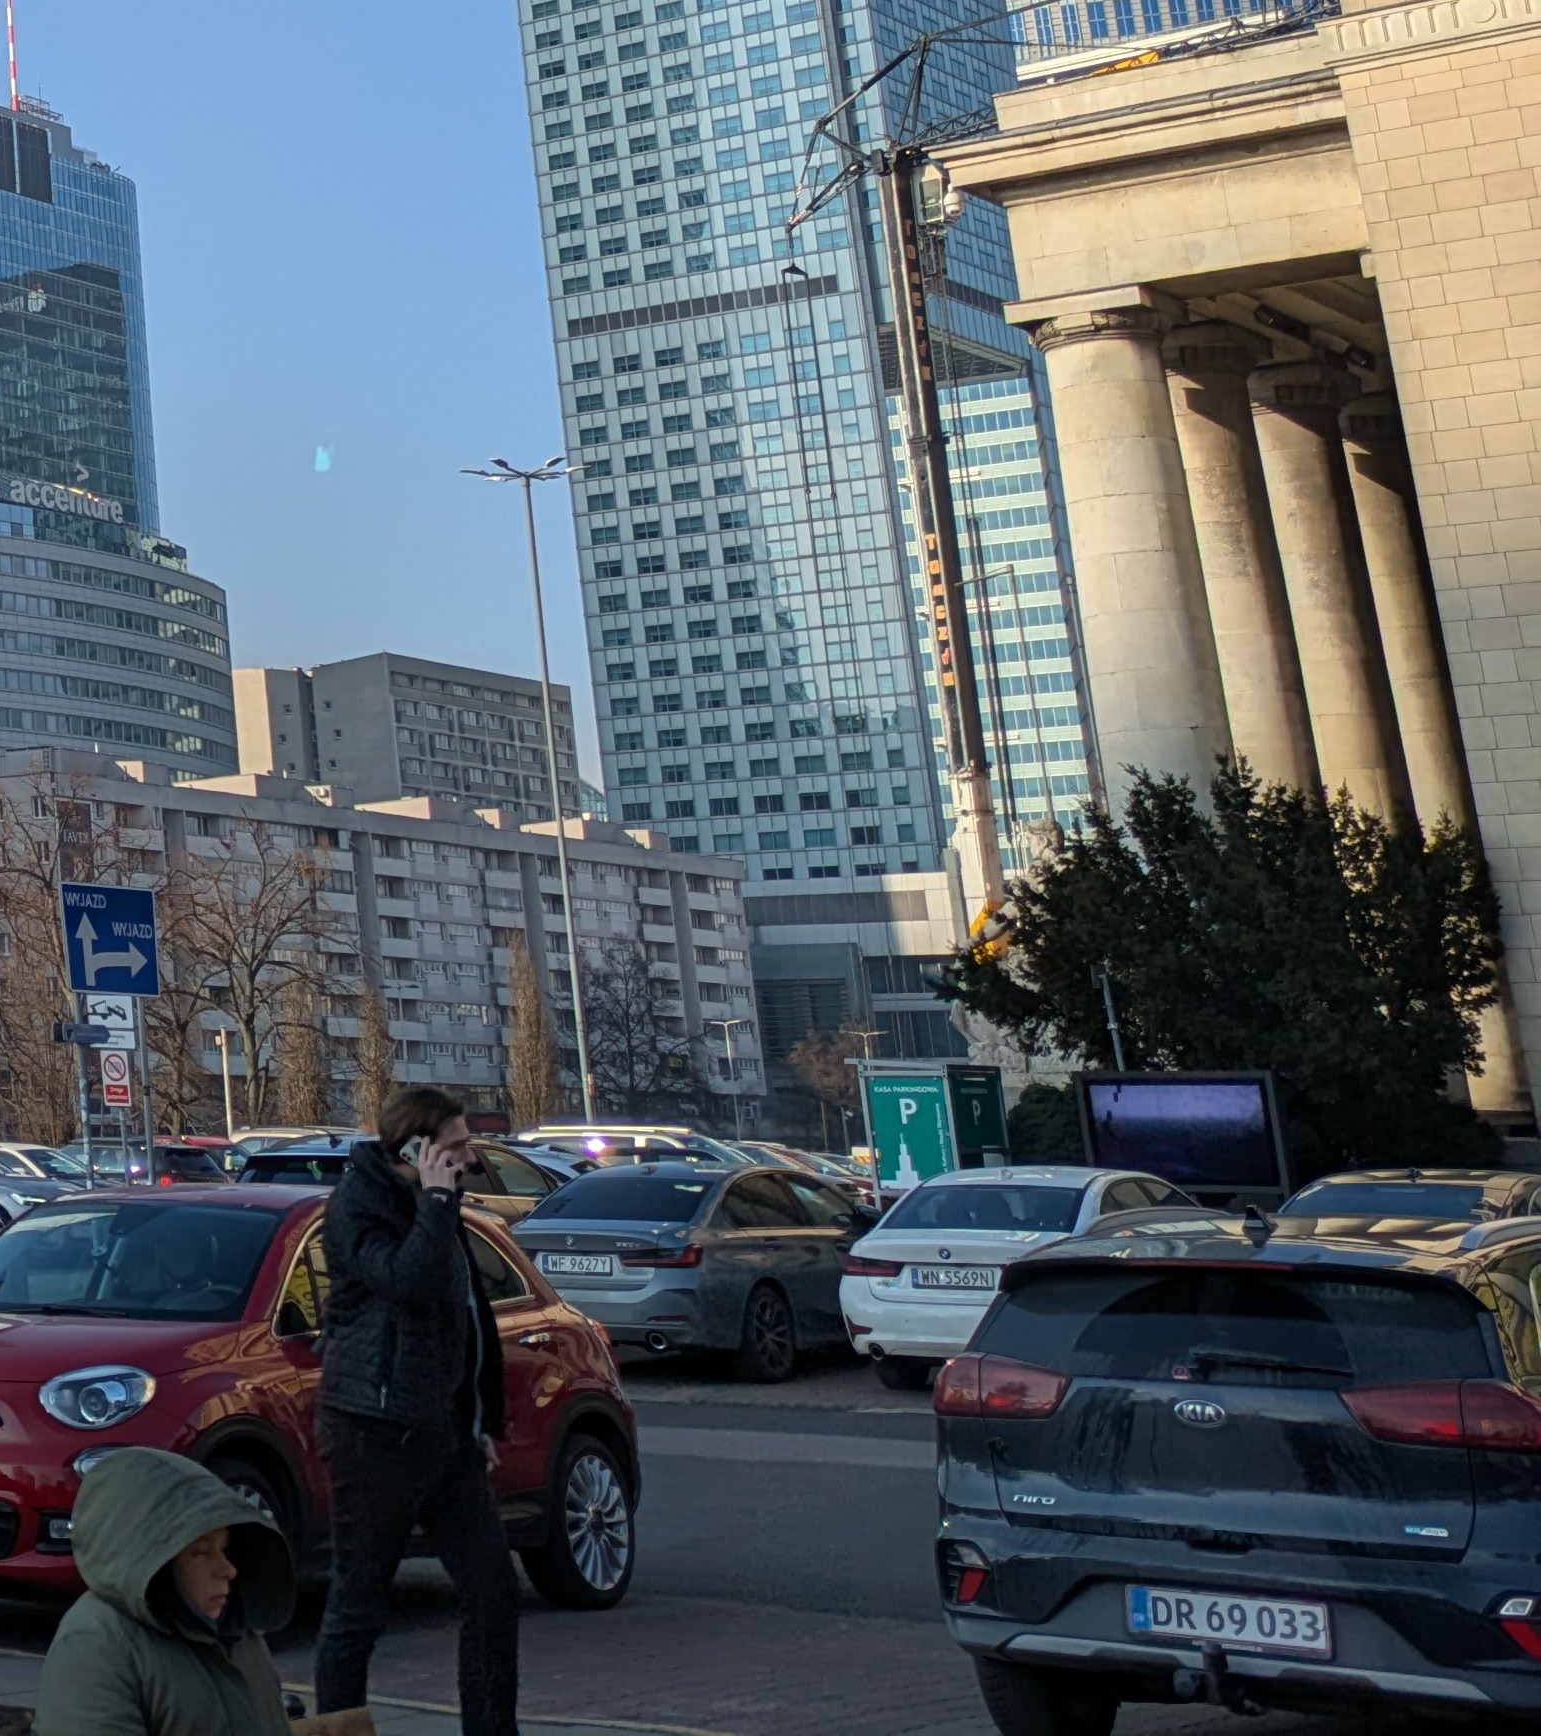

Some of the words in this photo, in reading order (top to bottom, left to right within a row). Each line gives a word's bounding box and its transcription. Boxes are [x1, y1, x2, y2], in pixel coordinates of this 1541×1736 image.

[10, 480, 124, 524] accenture
[64, 891, 107, 909] WYJAZD
[111, 921, 153, 939] WYJAZD
[550, 1256, 565, 1270] WF
[570, 1257, 607, 1272] 9627Y
[921, 1270, 940, 1285] WN
[945, 1271, 990, 1286] 5569N
[1182, 1404, 1217, 1421] KIA
[1151, 1595, 1197, 1631] DR
[1206, 1600, 1248, 1636] 69
[1256, 1605, 1322, 1642] 033
